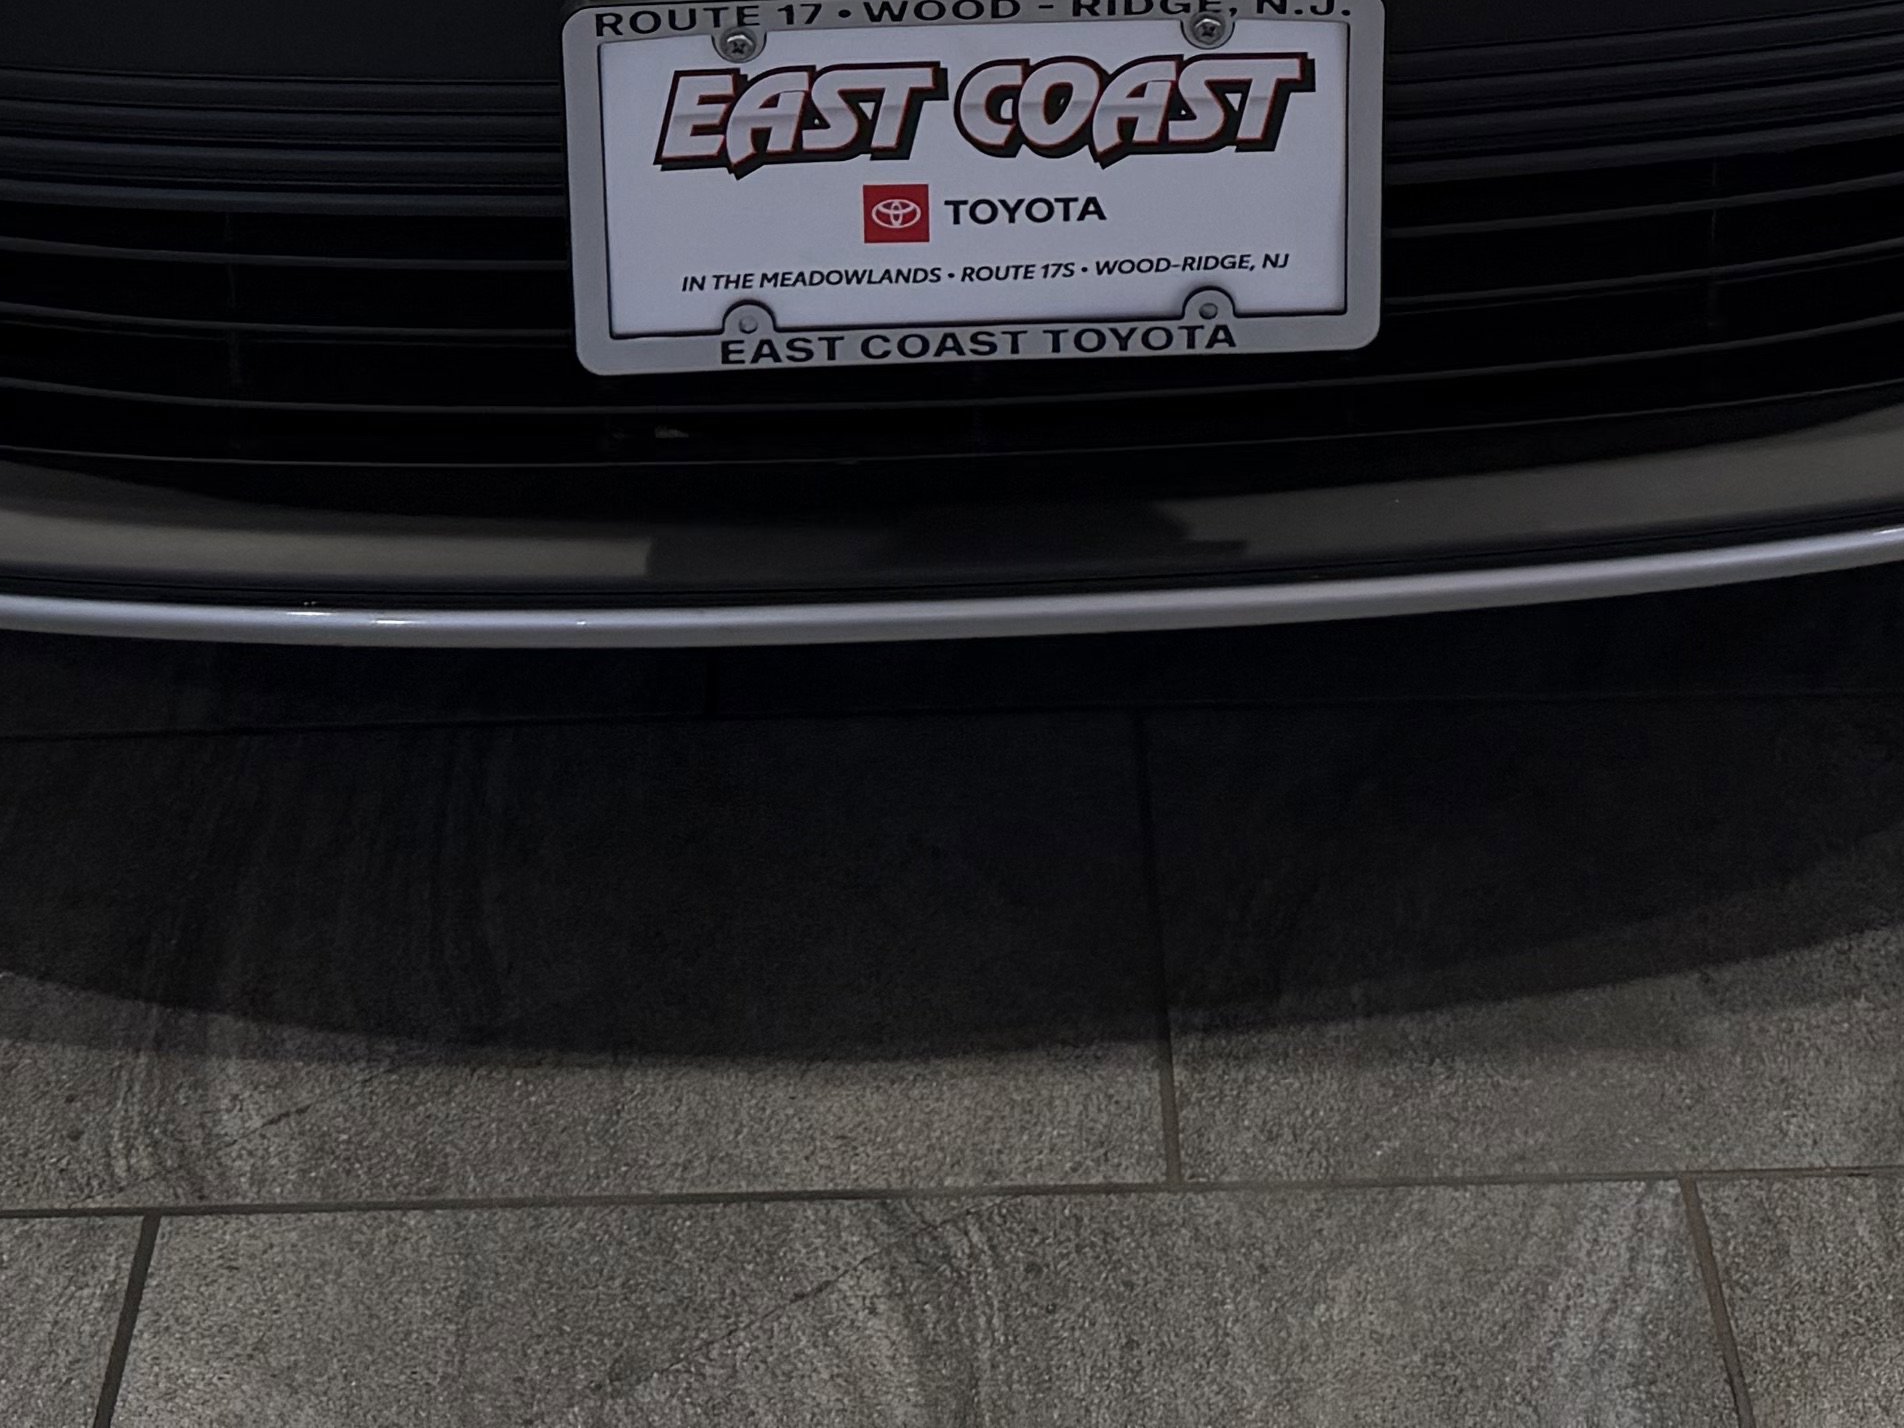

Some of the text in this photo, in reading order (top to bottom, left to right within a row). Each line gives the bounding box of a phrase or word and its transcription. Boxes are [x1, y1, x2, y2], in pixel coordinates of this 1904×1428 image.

[595, 3, 762, 37] ROUTE
[777, 2, 823, 26] 17
[653, 52, 1316, 180] EAST COAST
[944, 196, 1108, 225] TOYOTA
[681, 252, 1291, 292] IN THE MEADOWLANDS ROUTE 17S WOOD-RIDGE, NJ
[720, 324, 1237, 365] EAST COAST TOYOTA
